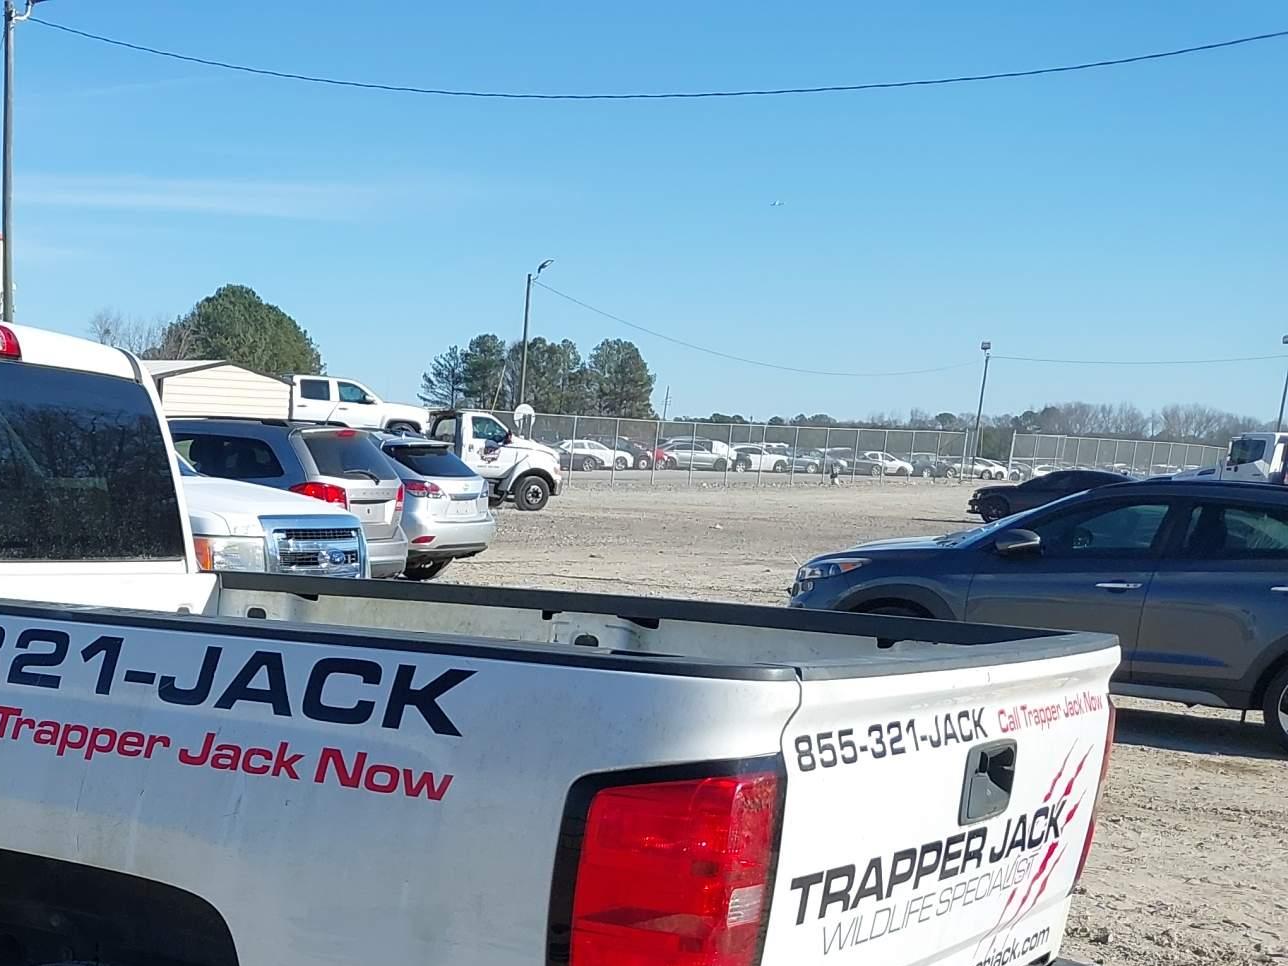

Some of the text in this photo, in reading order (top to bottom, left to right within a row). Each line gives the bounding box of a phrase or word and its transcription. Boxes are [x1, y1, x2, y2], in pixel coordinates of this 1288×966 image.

[794, 706, 989, 772] 855-321-JACK
[997, 690, 1103, 733] Call Trapper Jack Now
[178, 731, 304, 781] Jack
[314, 746, 454, 801] Now
[789, 799, 1067, 926] TRAPPER JACK
[822, 852, 1040, 956] WILDLIFE SPECIALIST
